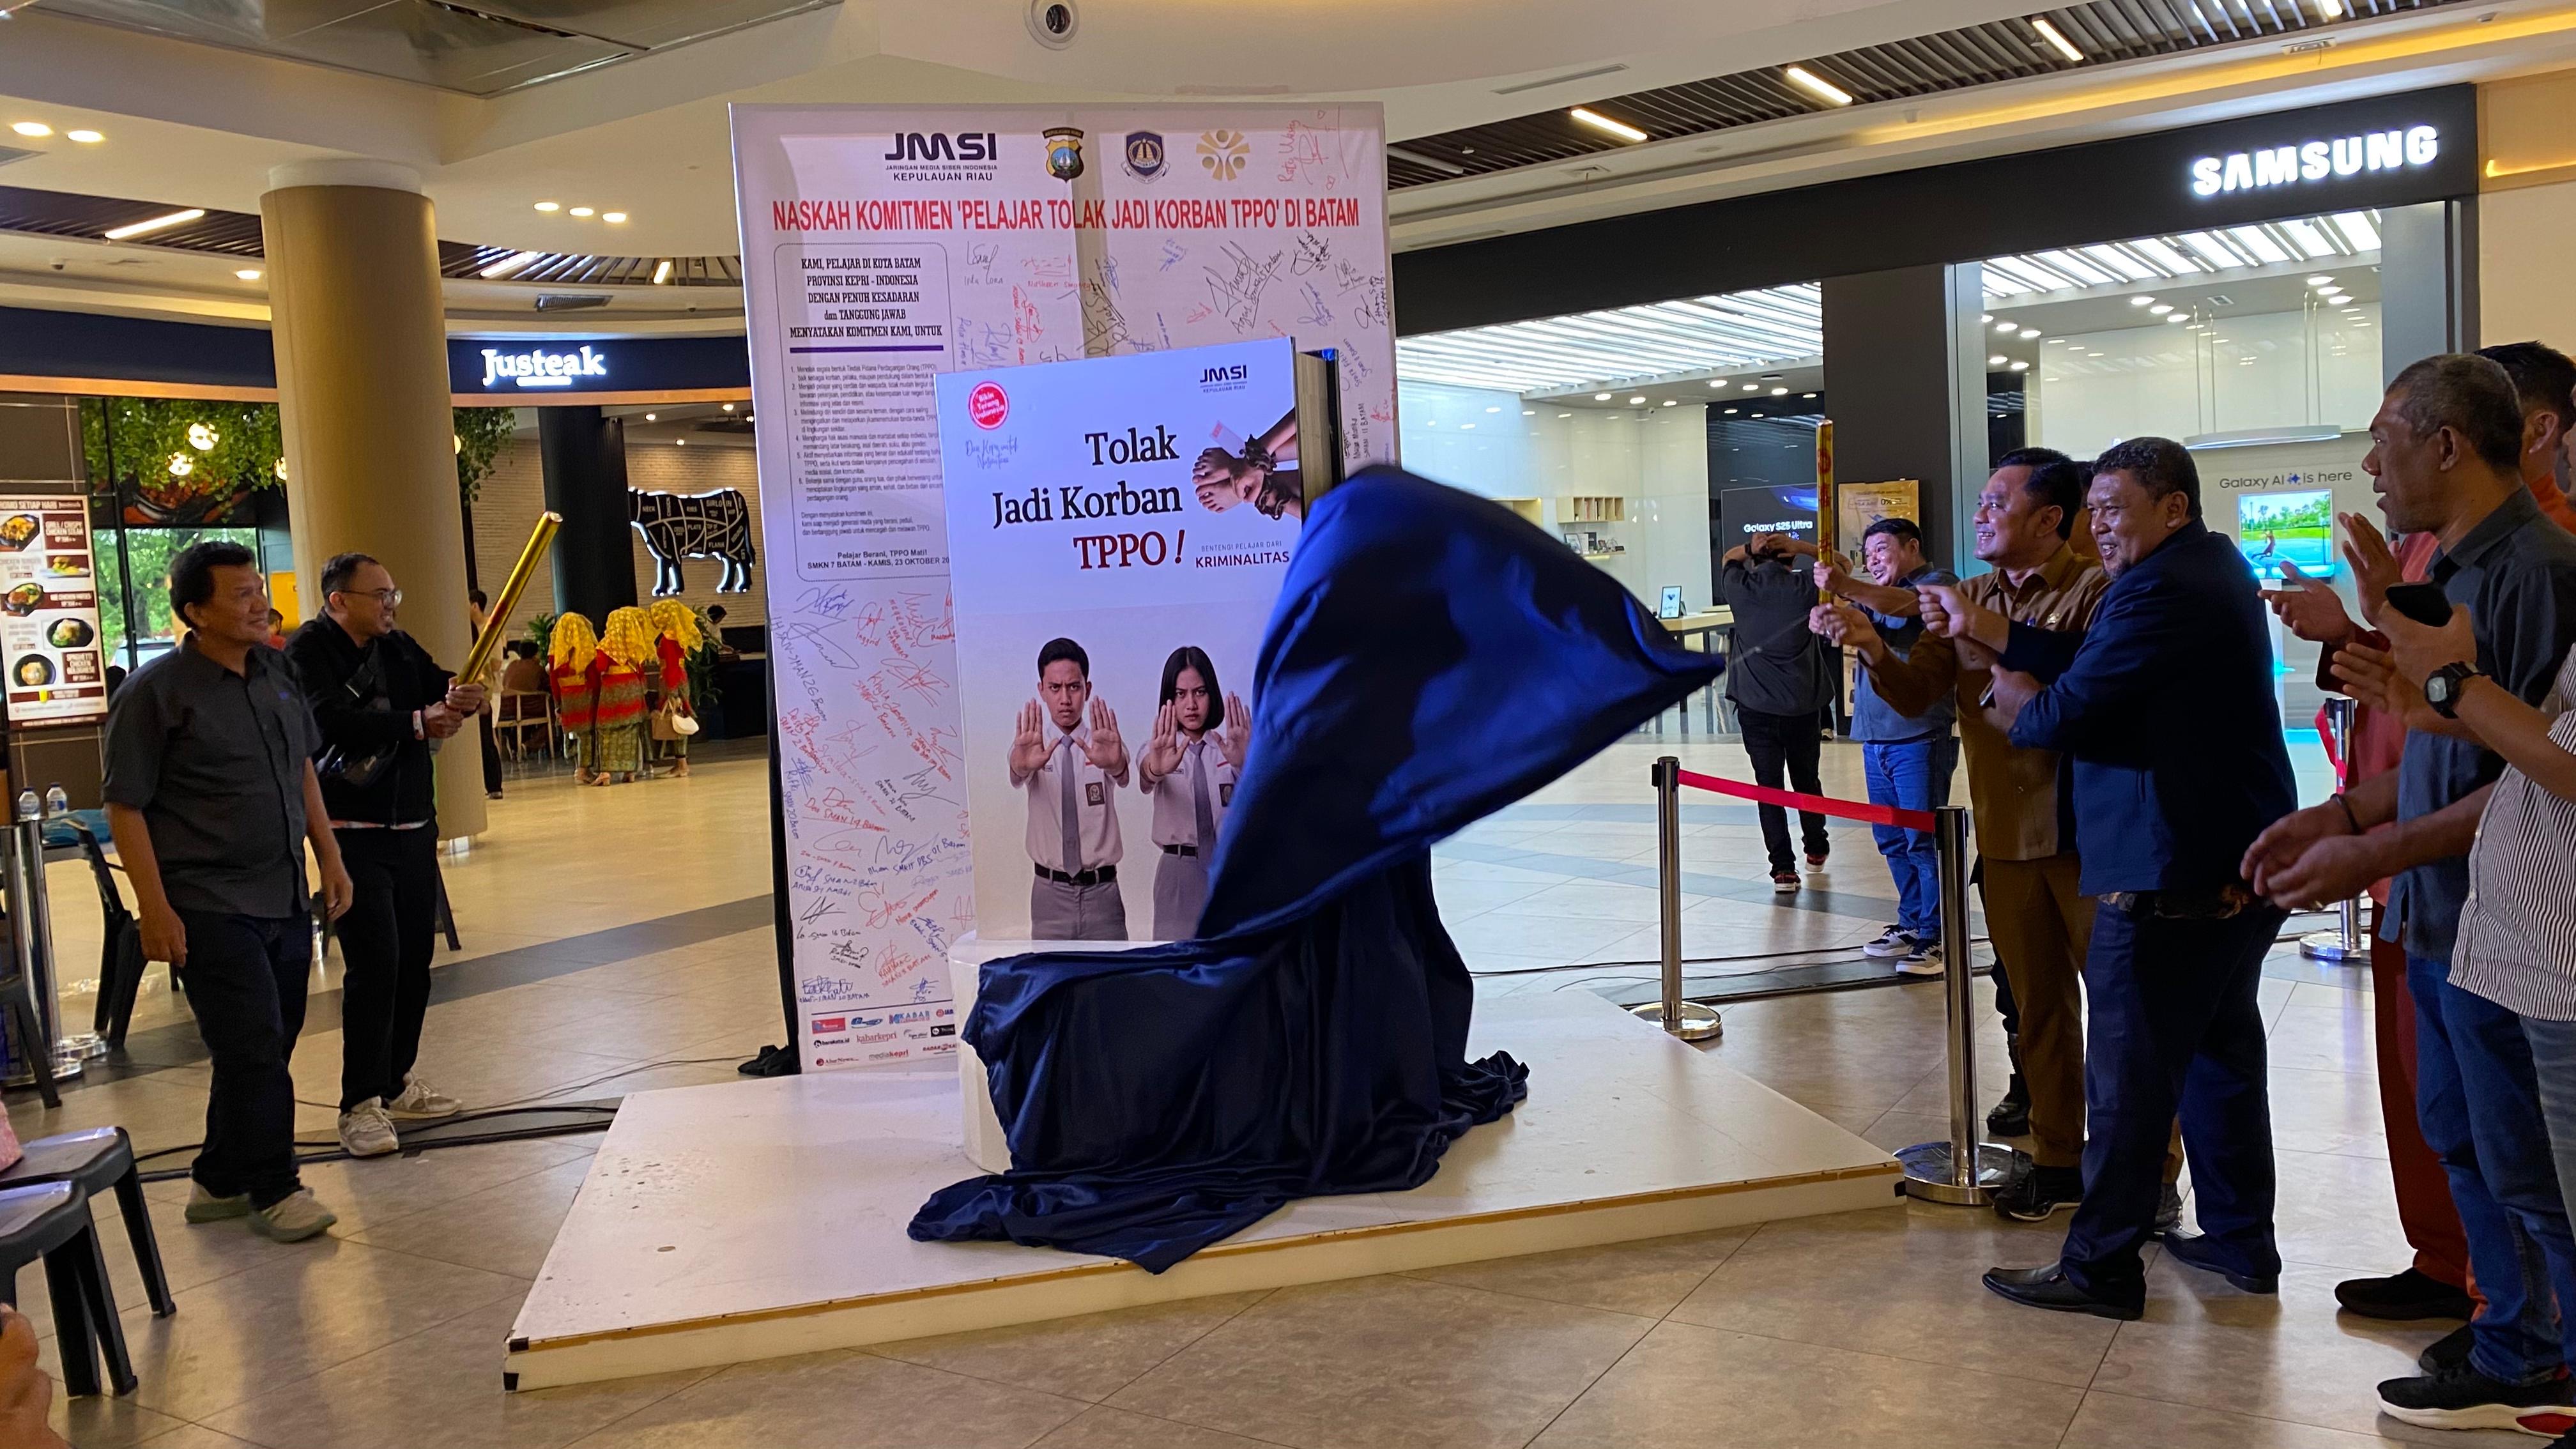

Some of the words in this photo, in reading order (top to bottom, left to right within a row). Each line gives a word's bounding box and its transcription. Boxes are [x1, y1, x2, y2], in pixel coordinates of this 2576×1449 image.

[884, 133, 997, 160] JMSI
[2193, 125, 2437, 195] SAMSUNG
[893, 172, 962, 181] KEPULAUAN
[967, 172, 992, 181] RIAU
[772, 200, 850, 231] NASKAH
[856, 200, 952, 230] KOMITMEN
[958, 199, 1044, 230] 'PELAJAR
[1047, 199, 1107, 229] TOLAK
[1112, 200, 1149, 229] JADI
[1154, 199, 1227, 228] KORBAN
[1231, 198, 1279, 228] TPPO'
[1285, 198, 1301, 227] DI
[1306, 198, 1360, 227] BATAM
[801, 258, 824, 270] KAMI,
[826, 258, 861, 270] PELAJAR
[862, 258, 871, 268] DI
[873, 258, 893, 268] KOTA
[894, 258, 921, 268] BATAM
[807, 275, 843, 286] PROVINSI
[845, 275, 869, 286] KEPRI
[876, 275, 918, 285] INDONESIA
[808, 293, 840, 303] DENGAN
[842, 292, 870, 302] PENUH
[871, 292, 919, 302] KESADARAN
[824, 310, 837, 320] dan
[839, 309, 879, 319] TANGGUNG
[882, 309, 906, 321] JAWAB
[790, 327, 844, 337] MENYATAKAN
[846, 326, 888, 337] KOMITMEN
[891, 326, 913, 337] KAMI,
[915, 325, 942, 336] UNTUK
[481, 346, 606, 387] Justeak
[1200, 365, 1247, 383] JMSI
[1085, 425, 1179, 466] Tolak
[2220, 477, 2269, 489] Galaxy
[2272, 475, 2284, 486] AI
[2303, 473, 2314, 483] is
[2318, 471, 2352, 482] here
[993, 488, 1052, 529] Jadi
[1061, 481, 1183, 519] Korban
[1744, 523, 1775, 533] Galaxy
[1775, 521, 1791, 530] S25
[1791, 521, 1813, 530] Ultra
[838, 551, 861, 560] Pelajar
[1073, 532, 1166, 570] TPPO
[1174, 530, 1185, 564] !
[1196, 551, 1289, 568] KRIMINALITAS
[856, 1032, 897, 1043] kabarkepri
[869, 1049, 908, 1061] mediakepri
